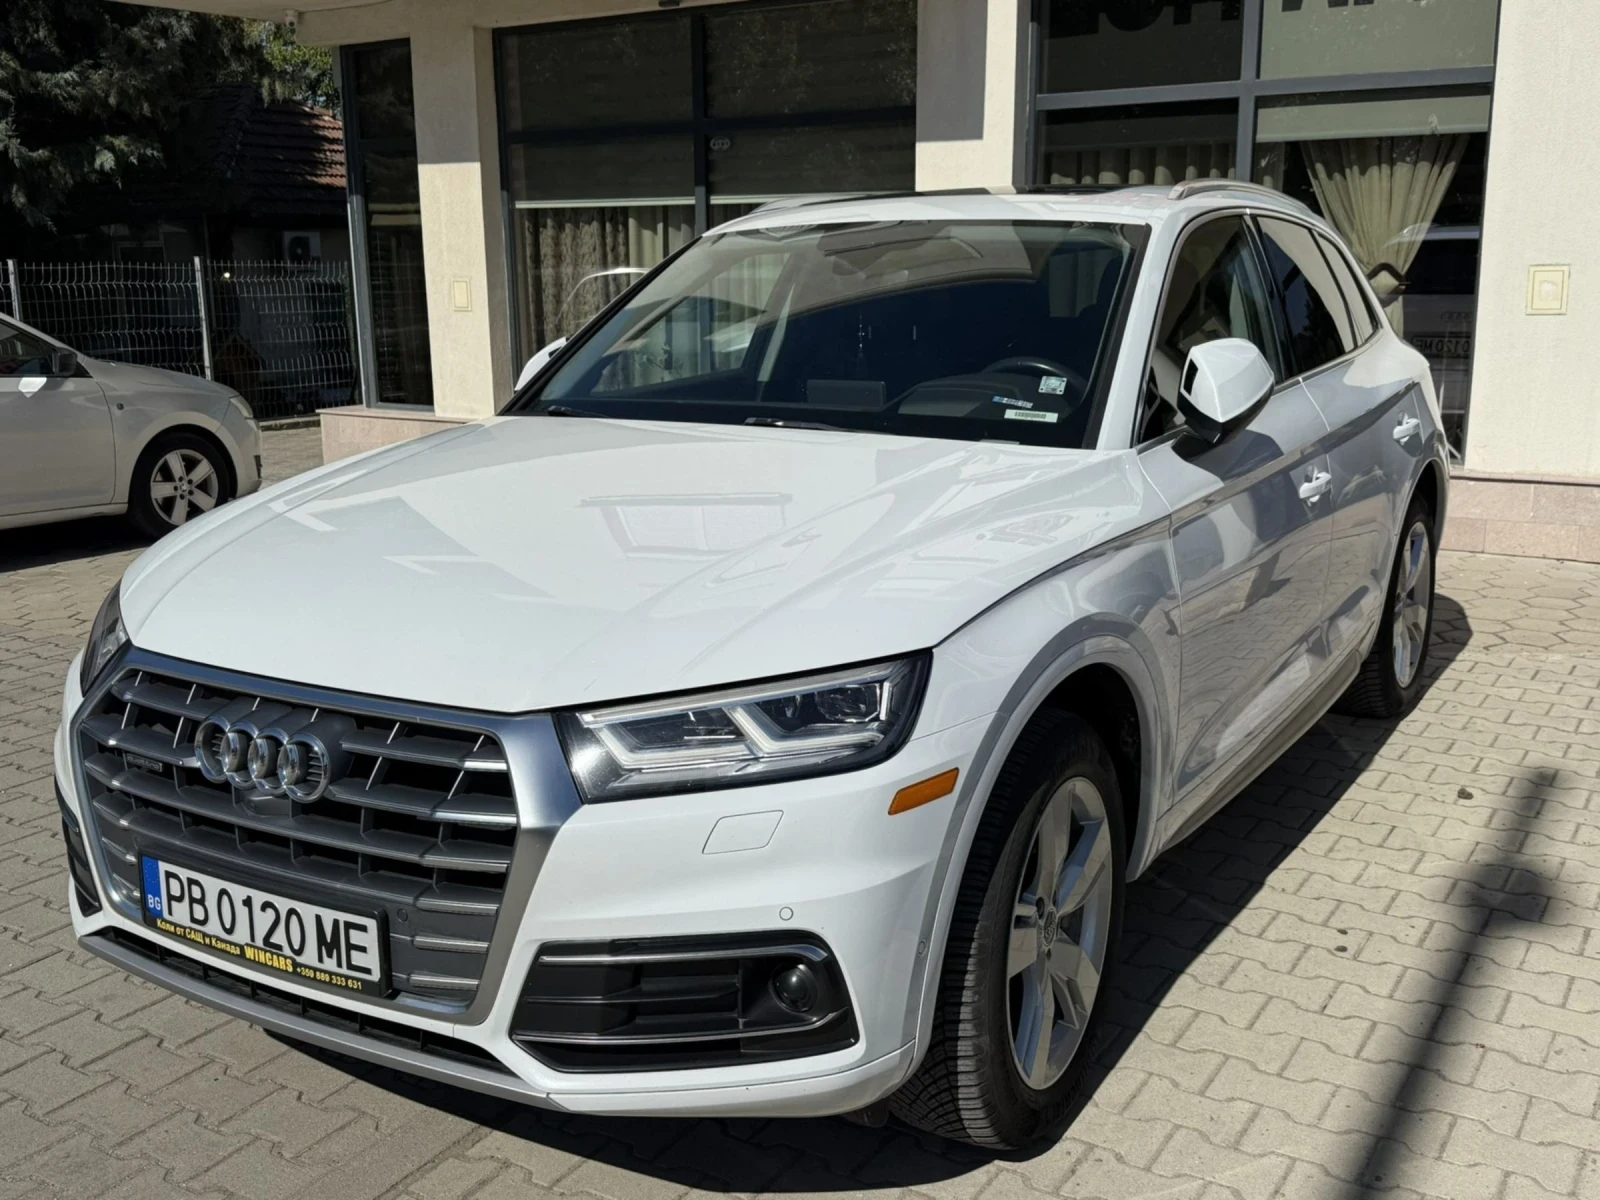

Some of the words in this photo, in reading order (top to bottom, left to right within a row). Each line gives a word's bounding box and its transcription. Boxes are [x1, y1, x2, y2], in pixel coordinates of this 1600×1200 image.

[147, 893, 162, 911] BG
[156, 918, 175, 933] Коли
[176, 926, 185, 937] от
[185, 928, 204, 945] САЩ
[211, 935, 241, 956] Канада
[164, 869, 209, 927] PB
[217, 888, 306, 957] 0120
[315, 913, 373, 976] ME
[244, 943, 294, 973] WINCARS
[296, 966, 315, 979] +359
[331, 975, 347, 987] 333
[347, 979, 363, 991] 631
